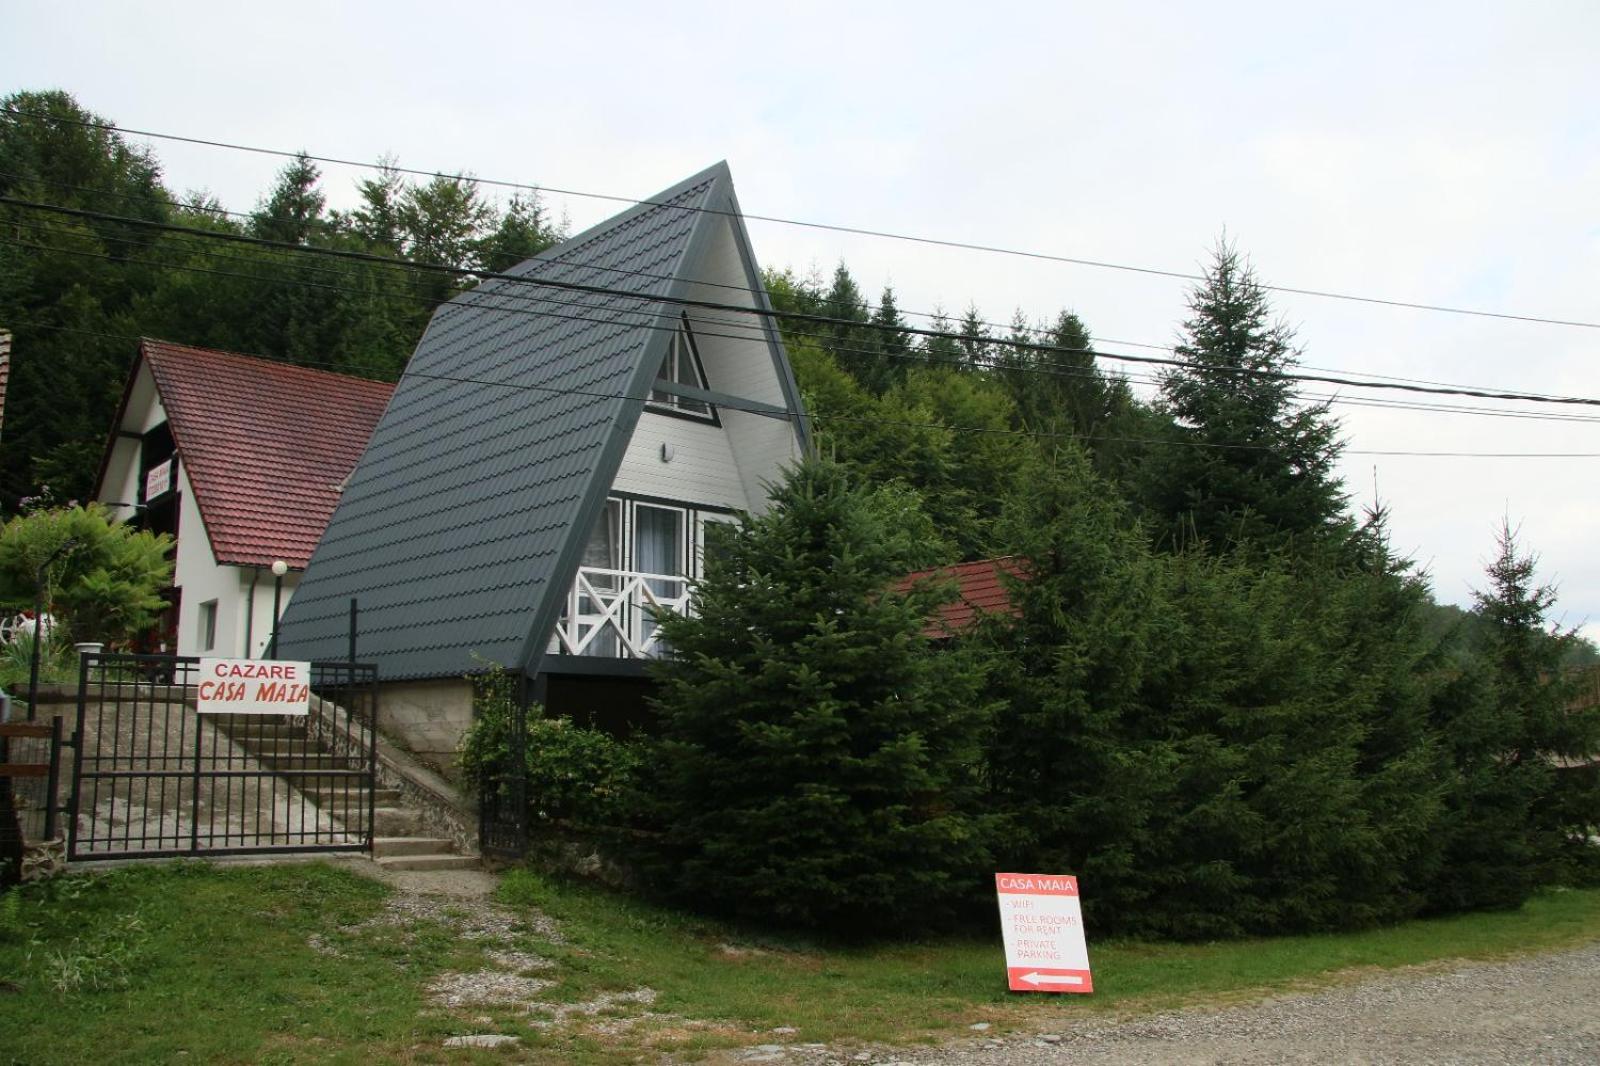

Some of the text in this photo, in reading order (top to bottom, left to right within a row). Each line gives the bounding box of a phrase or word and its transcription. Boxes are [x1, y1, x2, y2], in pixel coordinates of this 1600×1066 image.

[215, 663, 296, 680] CAZARE
[199, 681, 308, 703] CASA MAIA
[1000, 878, 1074, 891] CASA MAIA
[1014, 914, 1076, 926] FREE ROOMS
[1014, 924, 1062, 935] FOR RENT
[1017, 939, 1057, 950] PRIVATE
[1017, 950, 1062, 961] PARKING
